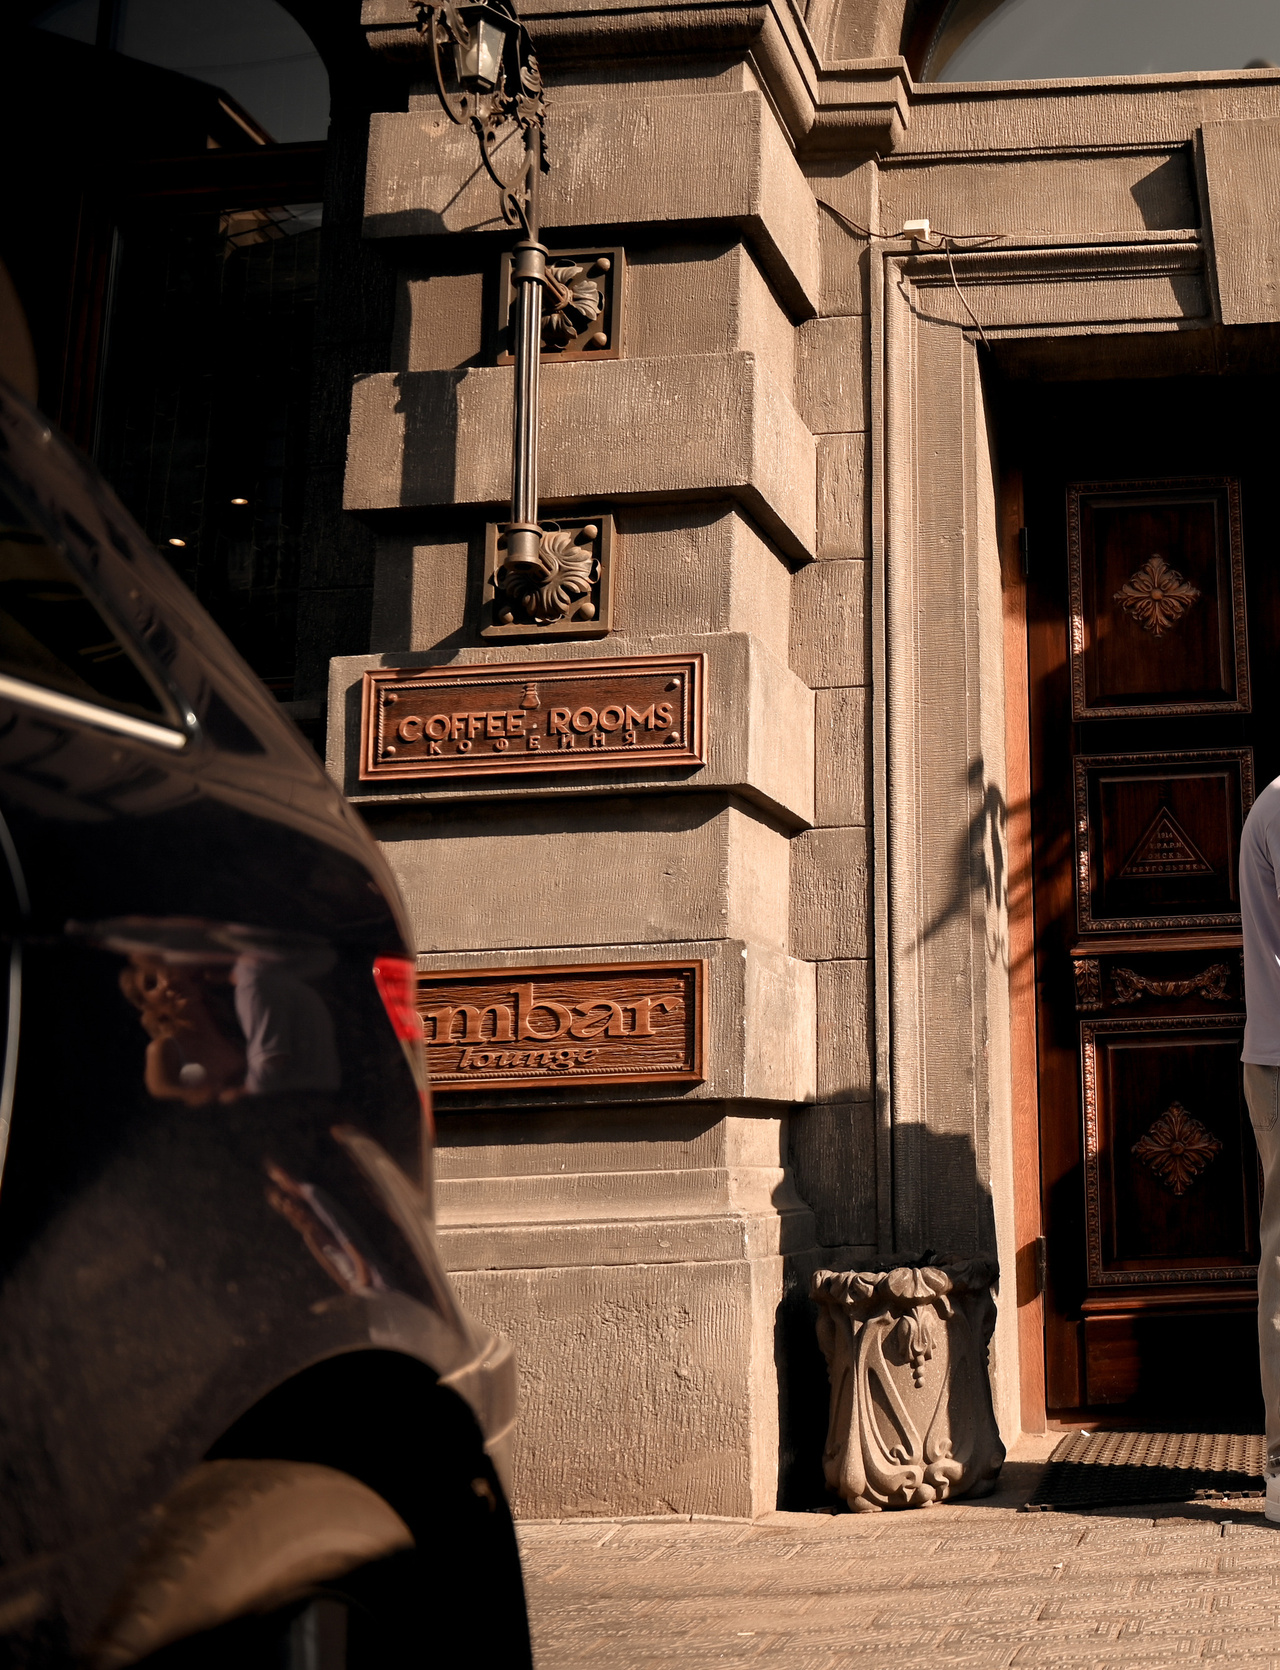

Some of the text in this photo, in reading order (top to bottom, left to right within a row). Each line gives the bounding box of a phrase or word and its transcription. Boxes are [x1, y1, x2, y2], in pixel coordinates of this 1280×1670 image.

[398, 702, 674, 742] COFFEE ROOMS
[416, 982, 684, 1045] mbar
[458, 1047, 600, 1071] lounge
